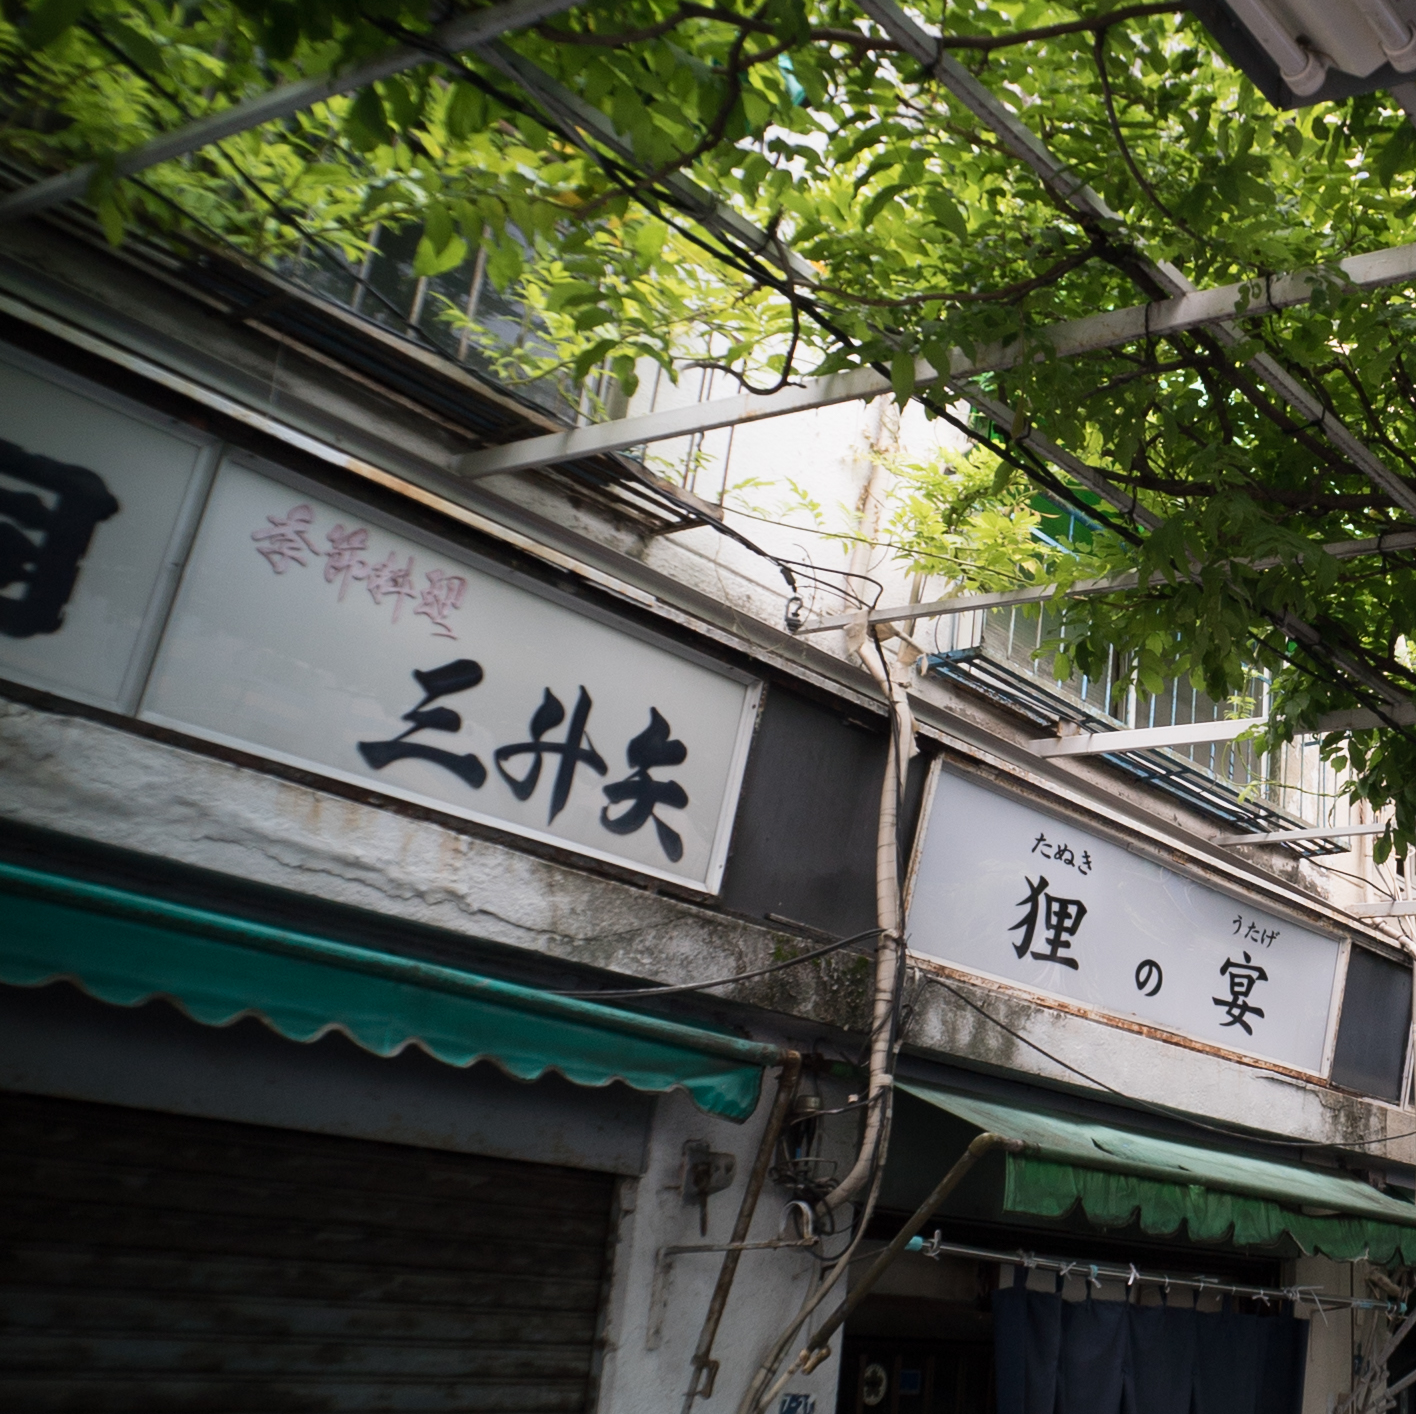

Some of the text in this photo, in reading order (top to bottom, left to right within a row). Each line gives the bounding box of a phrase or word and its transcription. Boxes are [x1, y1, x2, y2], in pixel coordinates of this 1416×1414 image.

[1031, 832, 1094, 876] たぬき
[1231, 913, 1281, 950] うたげ
[1007, 874, 1268, 1037] 狸の宴
